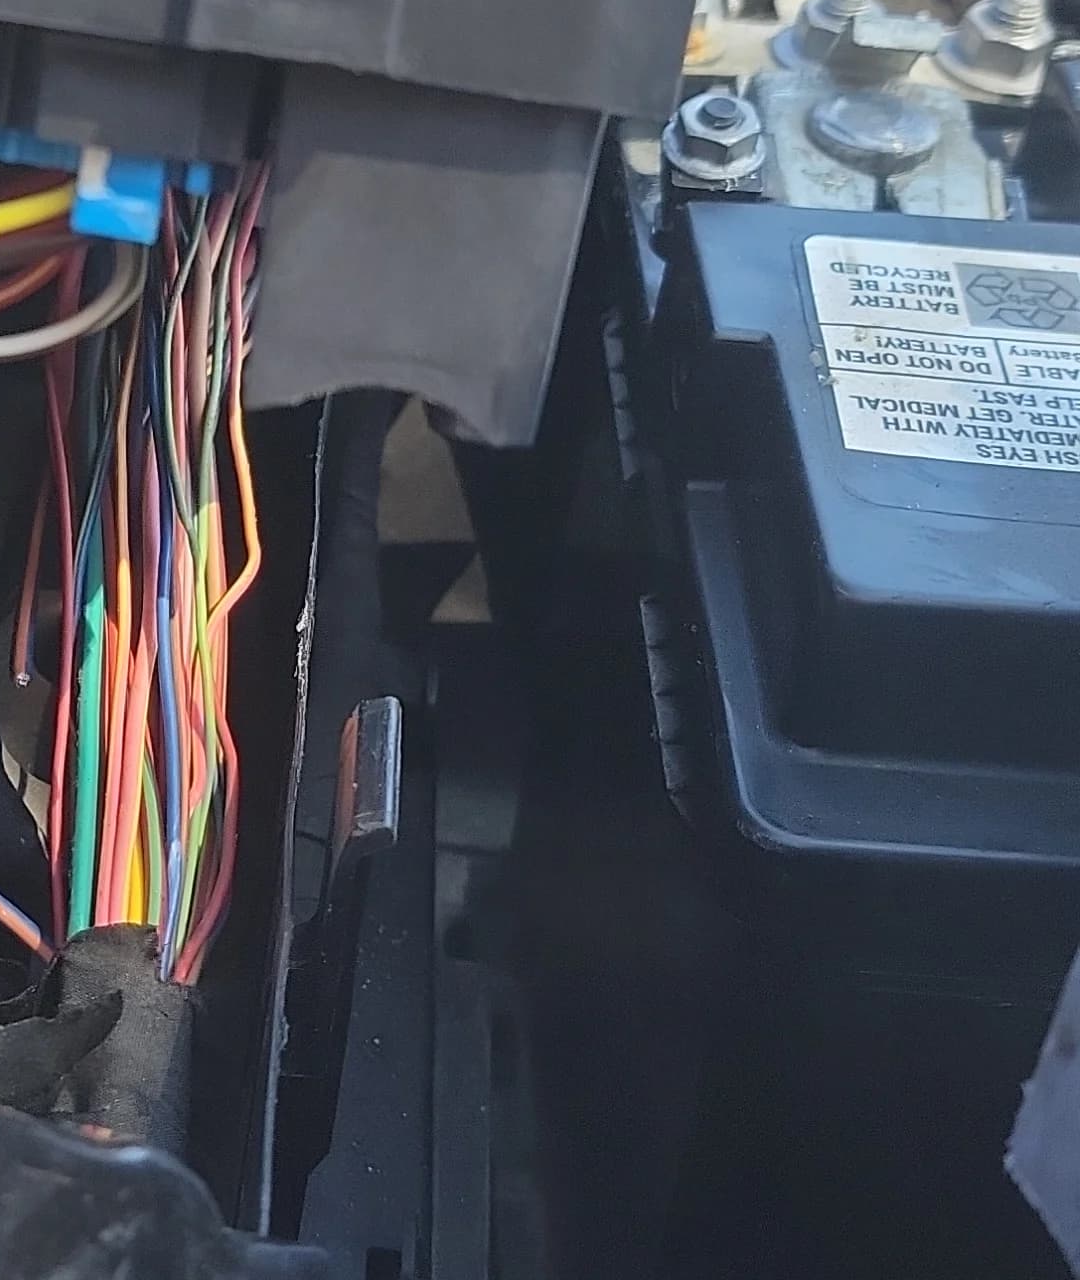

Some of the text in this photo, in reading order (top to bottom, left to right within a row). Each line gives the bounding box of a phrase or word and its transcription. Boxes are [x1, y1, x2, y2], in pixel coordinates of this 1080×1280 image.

[829, 261, 951, 282] RECYCLED
[849, 279, 956, 298] MUST BE
[850, 295, 959, 315] BATTERY
[874, 335, 987, 358] BATTERY!
[835, 348, 993, 376] DO NOT OPEN
[849, 396, 959, 419] MEDICAL
[973, 388, 1036, 408] FAST.
[967, 406, 1013, 423] GET
[883, 416, 946, 435] WITH
[976, 444, 1038, 462] EYES
